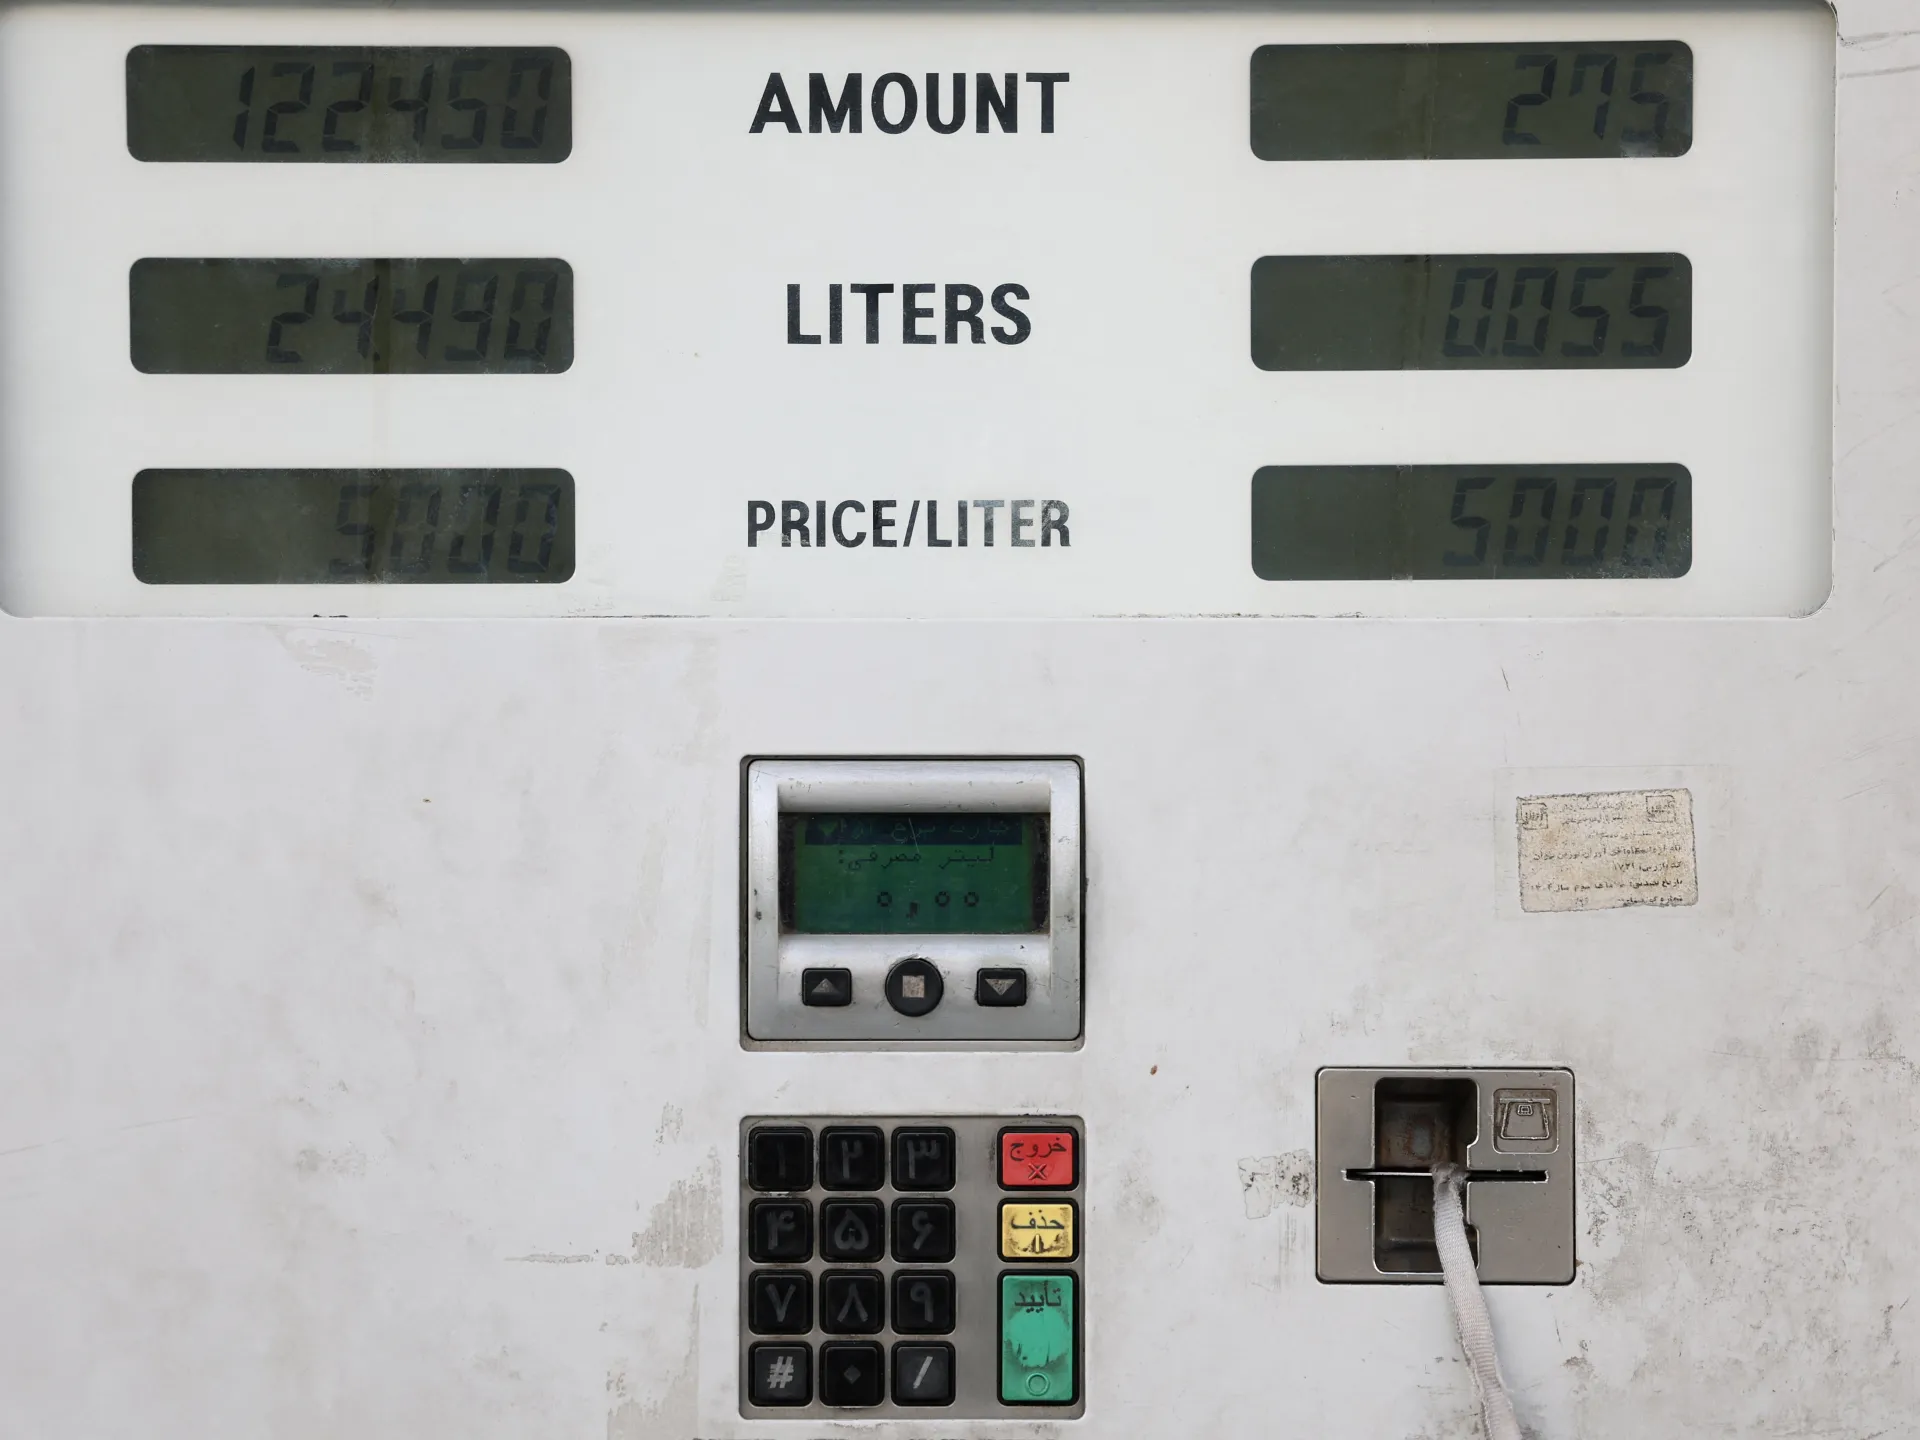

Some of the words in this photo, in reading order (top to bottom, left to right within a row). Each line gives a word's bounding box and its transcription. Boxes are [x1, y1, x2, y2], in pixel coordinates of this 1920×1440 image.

[232, 58, 555, 154] 122450
[748, 72, 1070, 134] AMOUNT
[1502, 53, 1673, 145] 275
[786, 282, 1032, 345] LITERS
[1443, 266, 1673, 358] 0.055
[747, 499, 1071, 547] PRICE/LITER
[841, 1139, 864, 1179] ۲
[906, 1139, 939, 1179] ۳
[1010, 1136, 1067, 1162] خروج
[766, 1209, 796, 1250] ۴
[834, 1207, 870, 1251] ۵
[911, 1209, 936, 1250] ۶
[1010, 1209, 1065, 1230] حذف
[765, 1283, 797, 1323] ۷
[836, 1283, 869, 1323] ۸
[909, 1283, 934, 1323] ۹
